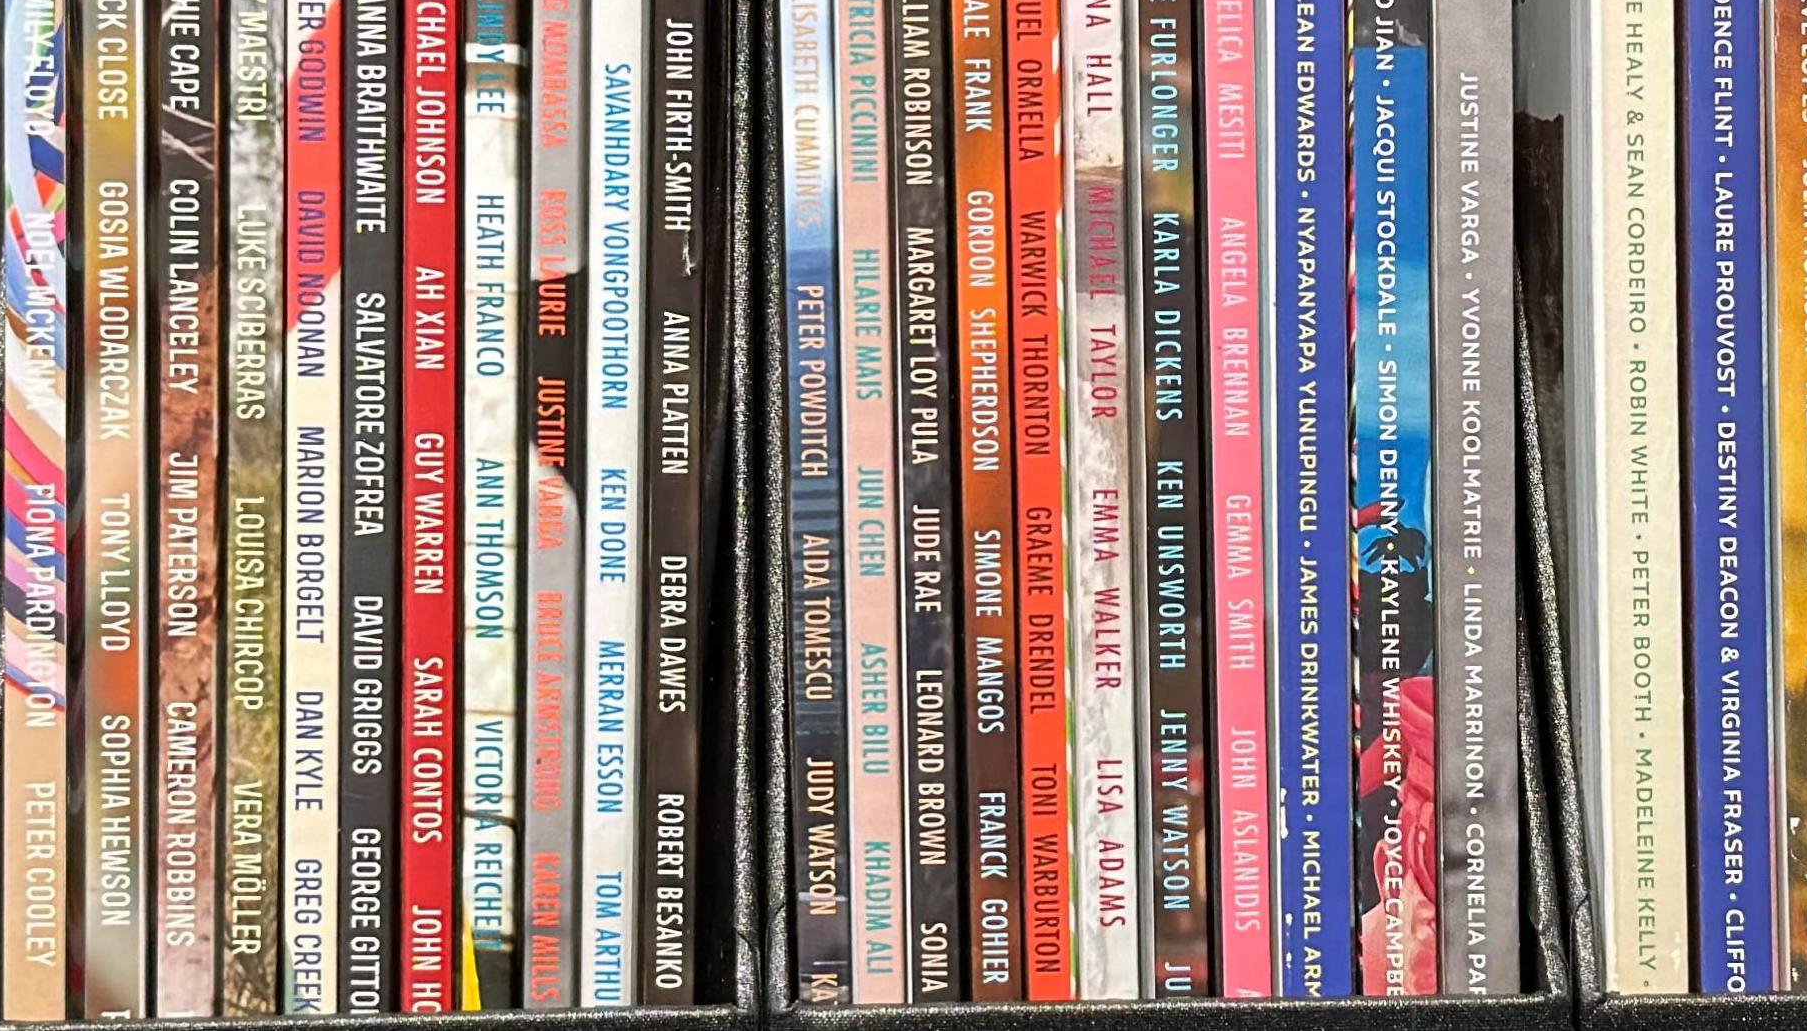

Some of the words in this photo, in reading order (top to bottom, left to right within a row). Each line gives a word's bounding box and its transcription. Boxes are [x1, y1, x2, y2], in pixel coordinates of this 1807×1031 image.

[170, 45, 198, 111] CAPE
[1375, 17, 1395, 71] JIAN
[1626, 22, 1644, 99] HEALY
[850, 75, 879, 182] PICCININI
[965, 59, 991, 131] FRANK
[1150, 18, 1180, 172] FURLONGER
[356, 64, 387, 234] BRAITHWAITE
[296, 426, 324, 525] MARION
[476, 458, 504, 508] ANN
[601, 469, 626, 513] KEN
[296, 534, 324, 643] BORGELT
[476, 516, 504, 639] THOMSON
[600, 521, 626, 584] DONE
[1463, 584, 1484, 658] LINDA
[1465, 666, 1485, 799] MARRINON
[25, 782, 55, 859] PETER
[804, 757, 833, 815] JUDY
[657, 794, 685, 878] ROBERT
[808, 823, 835, 915] WATSON
[25, 867, 55, 966] COOLEY
[655, 885, 683, 989] BESANKO
